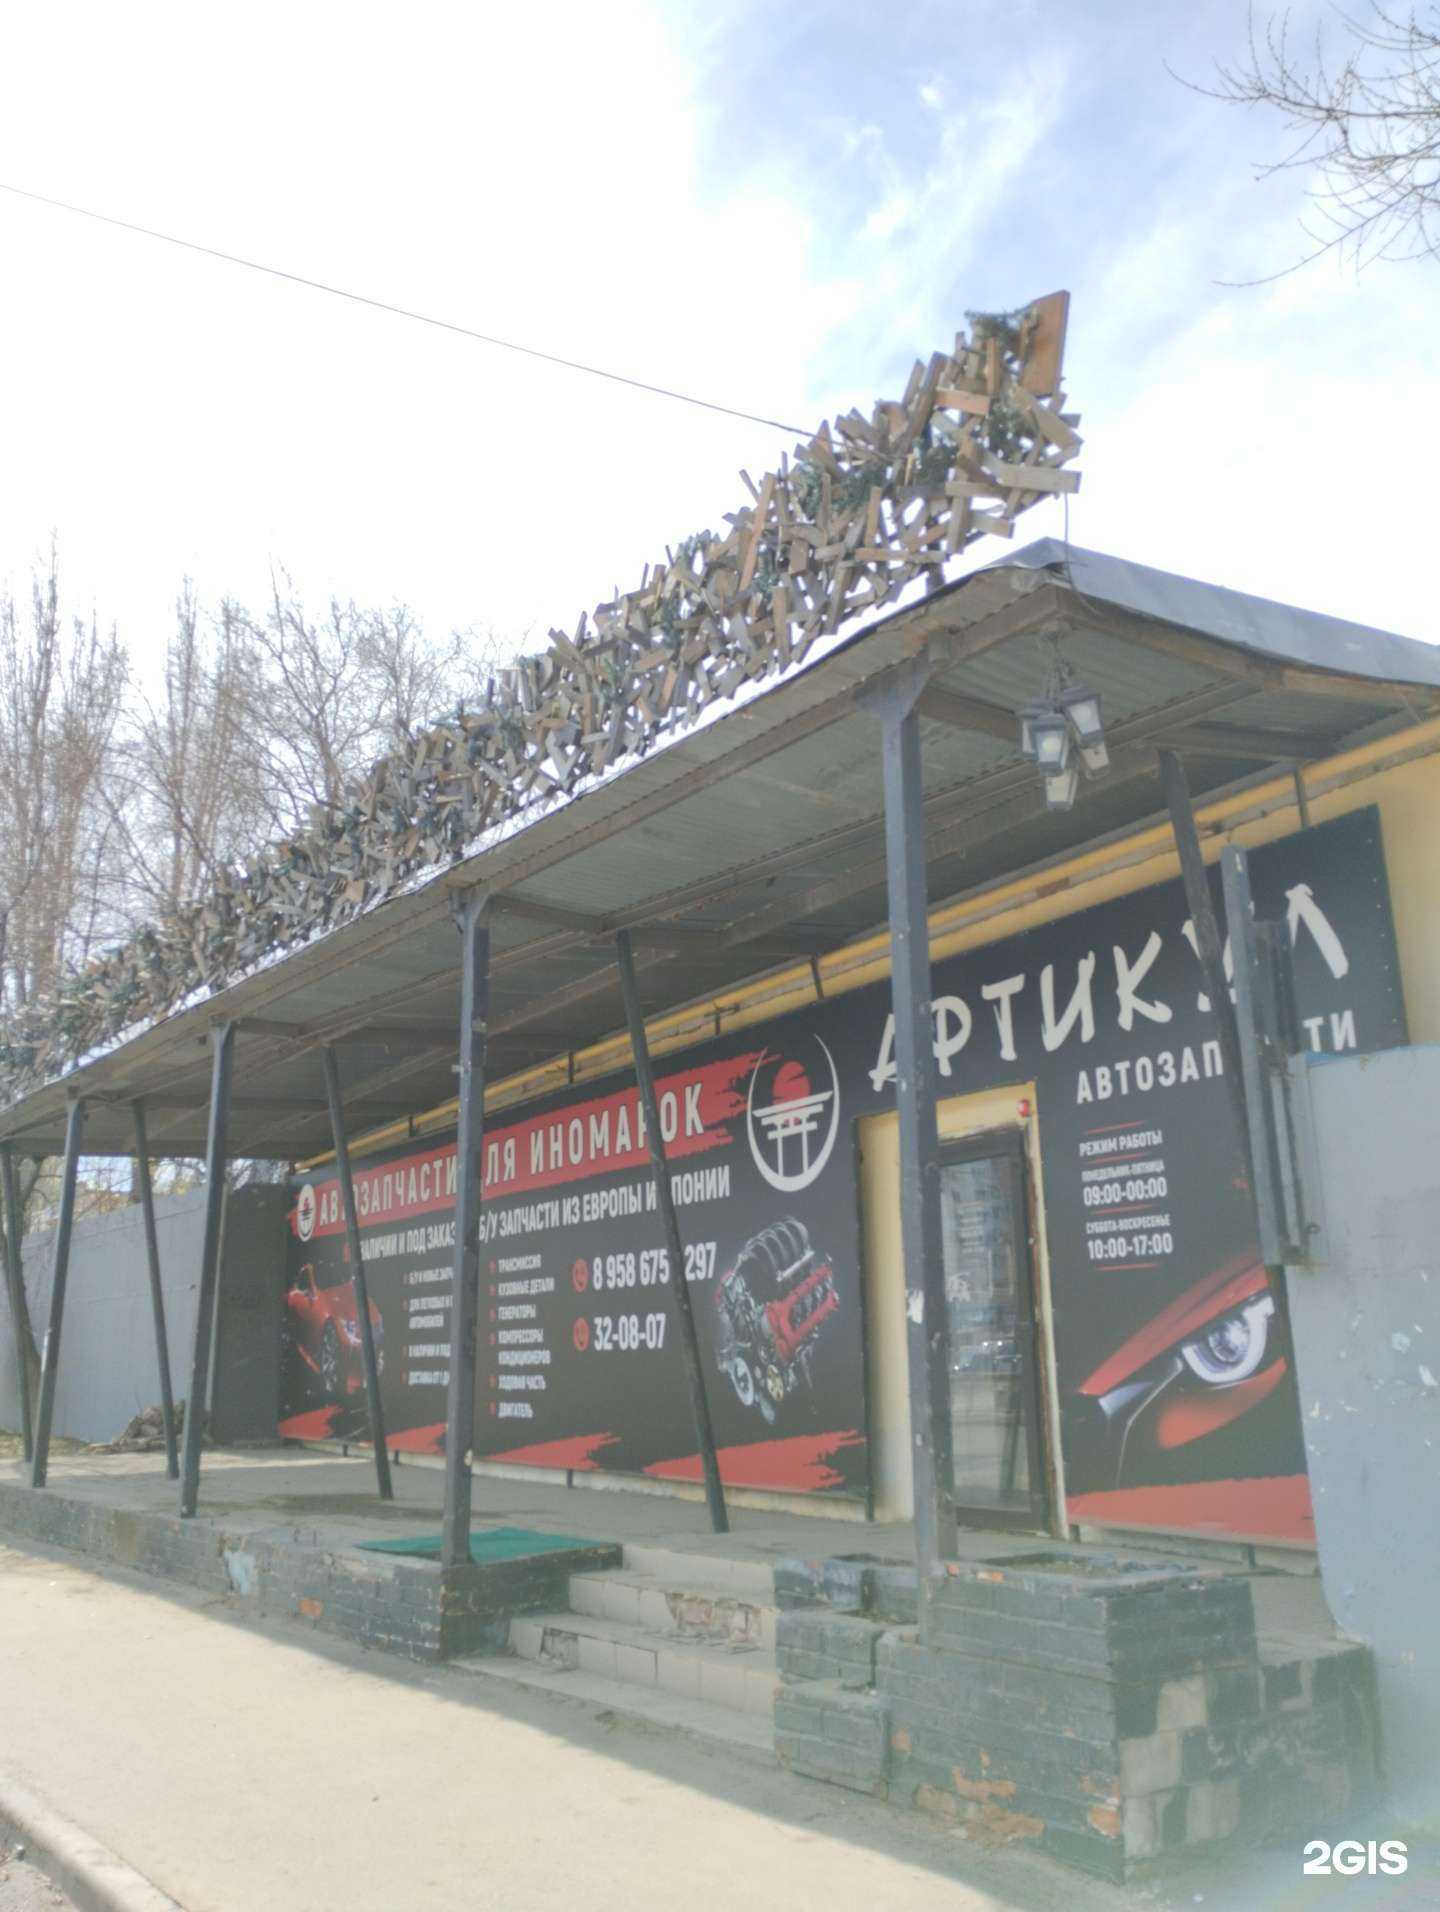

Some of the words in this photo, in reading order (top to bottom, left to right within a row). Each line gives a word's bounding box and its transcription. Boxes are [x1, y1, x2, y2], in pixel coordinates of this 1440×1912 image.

[1077, 1009, 1357, 1104] АВТОЗАПТИ
[1079, 1137, 1118, 1157] РЕЖИМ
[1119, 1129, 1163, 1151] РАБОТЫ
[407, 1228, 427, 1255] ПОД
[478, 1210, 499, 1243] Б/У
[499, 1199, 560, 1238] ЗАПЧАСТИ
[562, 1196, 581, 1226] ИЗ
[583, 1181, 643, 1222] ЕВРОПЫ
[645, 1180, 657, 1212] И
[671, 1164, 730, 1206] ПОНИИ
[1087, 1232, 1174, 1261] 10:00-17:00
[592, 1256, 603, 1290] 8
[606, 1252, 636, 1289] 958
[639, 1248, 670, 1286] 675
[593, 1312, 666, 1351] 32-08-07
